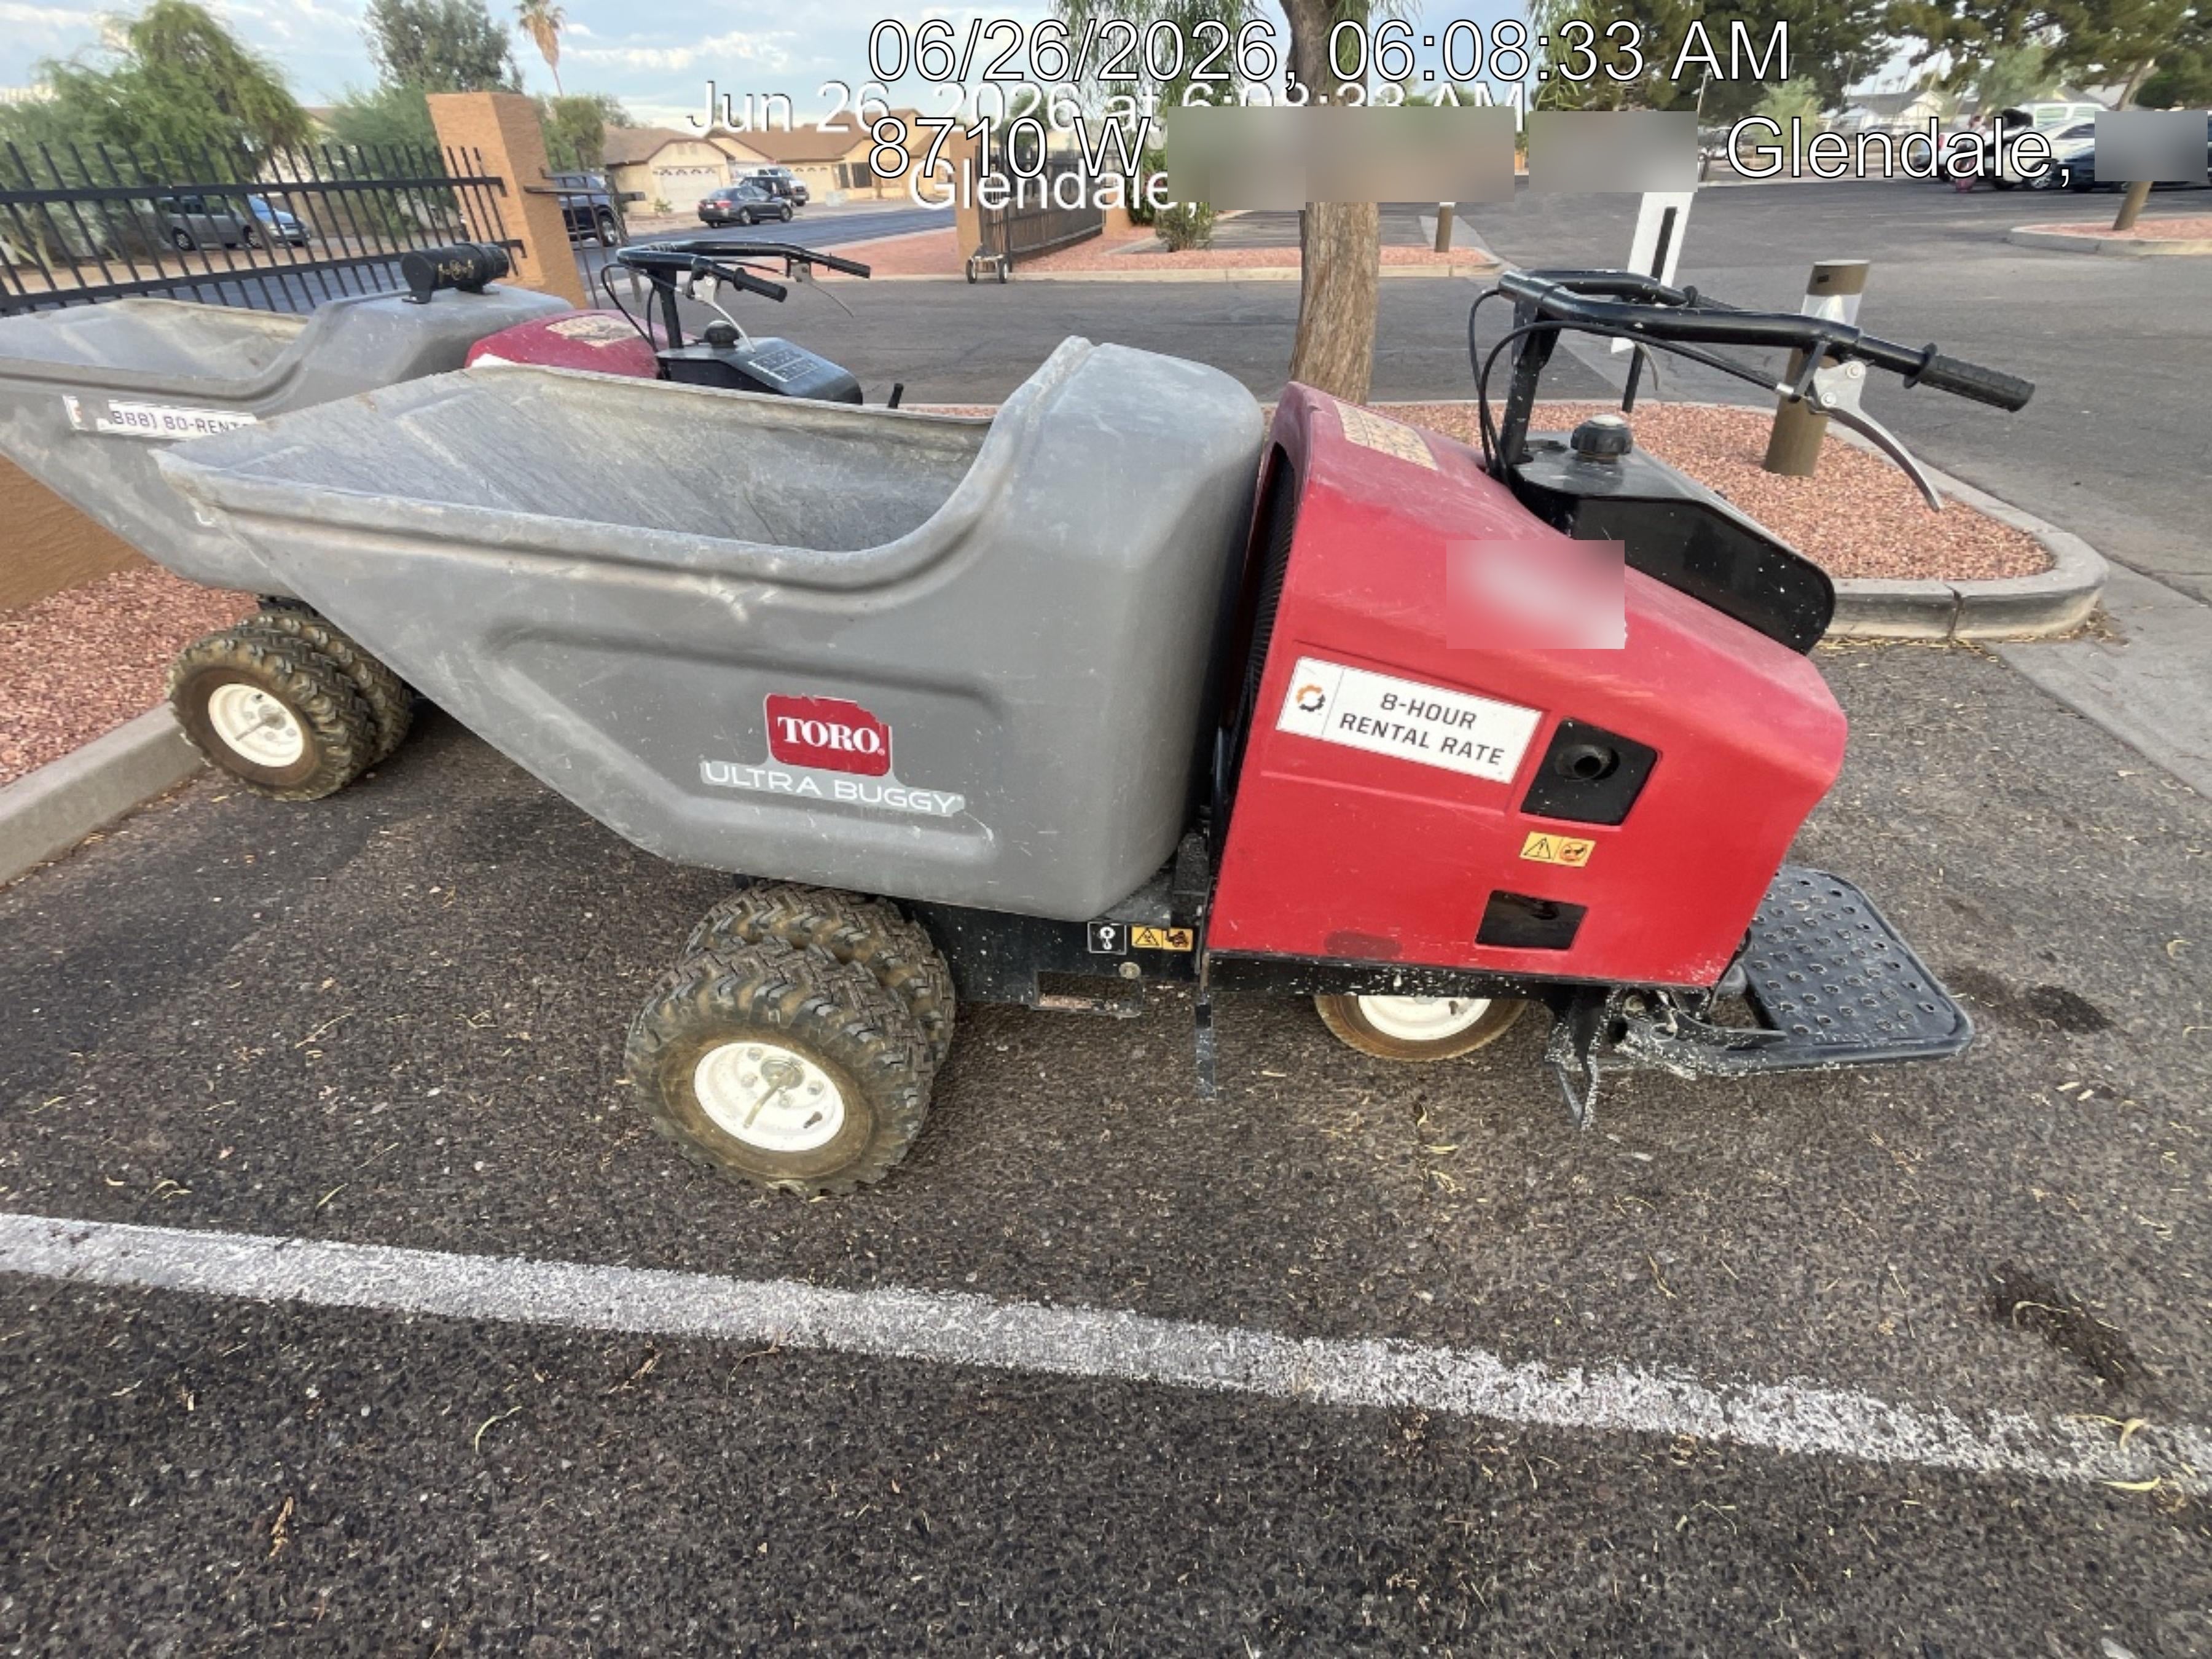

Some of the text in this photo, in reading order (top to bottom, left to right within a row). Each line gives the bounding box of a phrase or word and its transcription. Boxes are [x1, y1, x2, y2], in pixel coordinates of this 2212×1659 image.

[163, 415, 248, 434] 80-RENT
[1379, 692, 1477, 730] 8-HOUR
[1339, 712, 1505, 766] RENTAL RATE
[705, 762, 956, 814] ULTRA BUGGY
